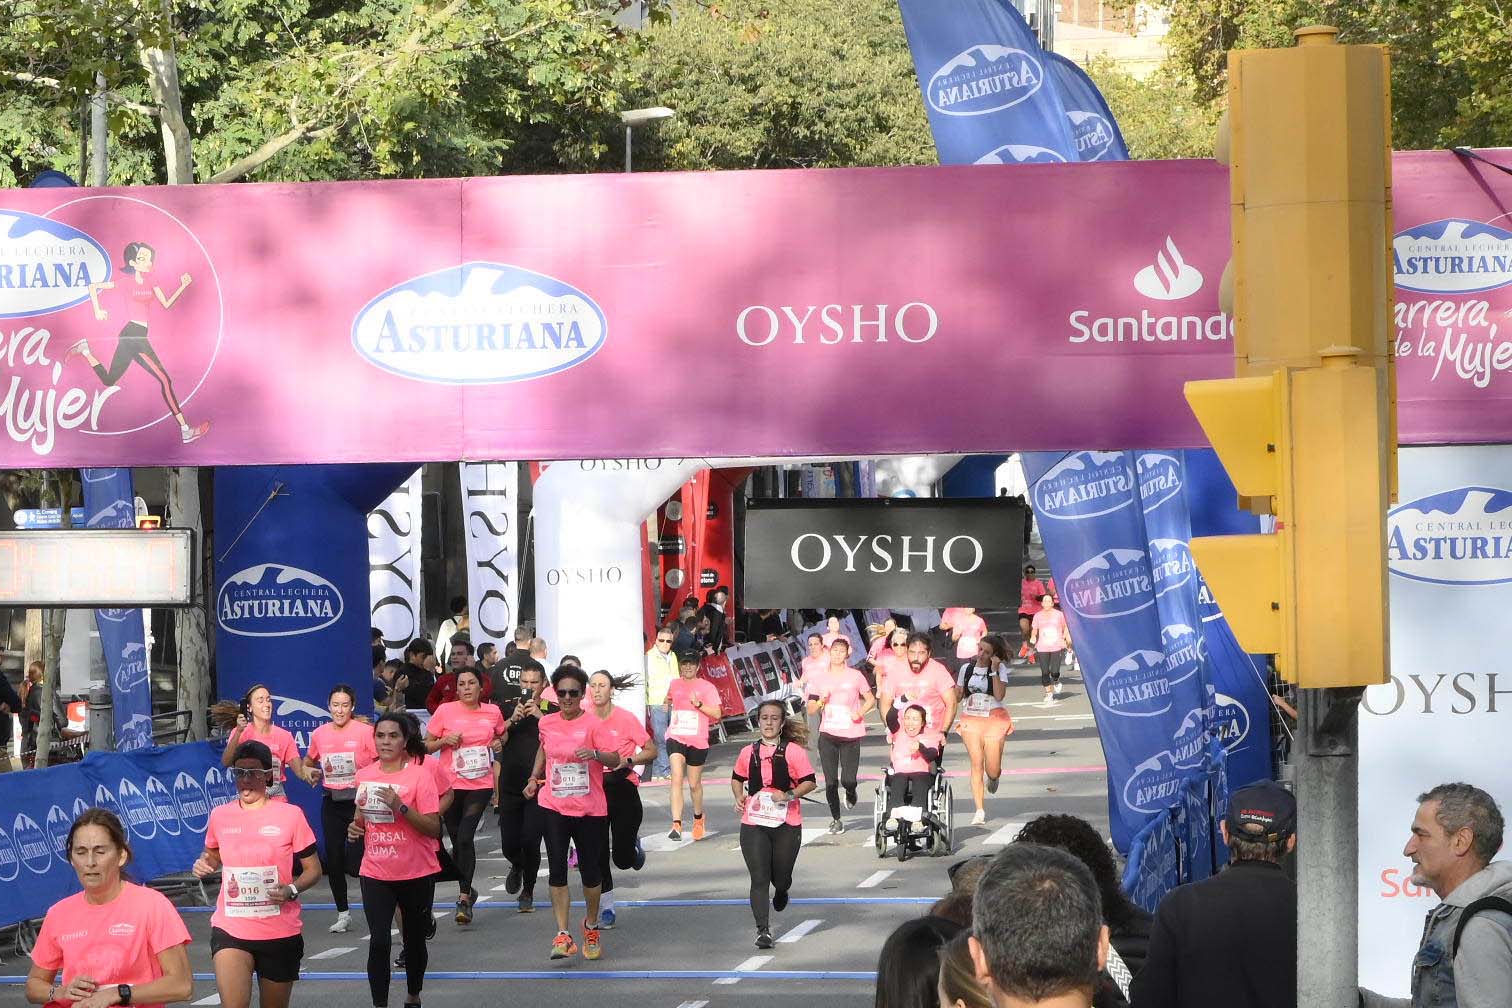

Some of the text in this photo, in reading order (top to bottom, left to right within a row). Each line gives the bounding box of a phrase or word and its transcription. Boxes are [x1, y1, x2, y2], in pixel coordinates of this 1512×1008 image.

[15, 245, 87, 257] LECHERA
[375, 308, 587, 353] ASTURIANA
[737, 302, 938, 346] OYSHO
[1069, 310, 1233, 343] Santand
[1418, 324, 1512, 388] la Muje
[1414, 521, 1482, 532] CENTRAL
[790, 533, 984, 574] OYSHO
[546, 566, 623, 586] OYSHO
[221, 593, 334, 620] ASTURIANA
[235, 588, 329, 598] CENTRAL LECHERA
[1361, 672, 1512, 716] OYSH
